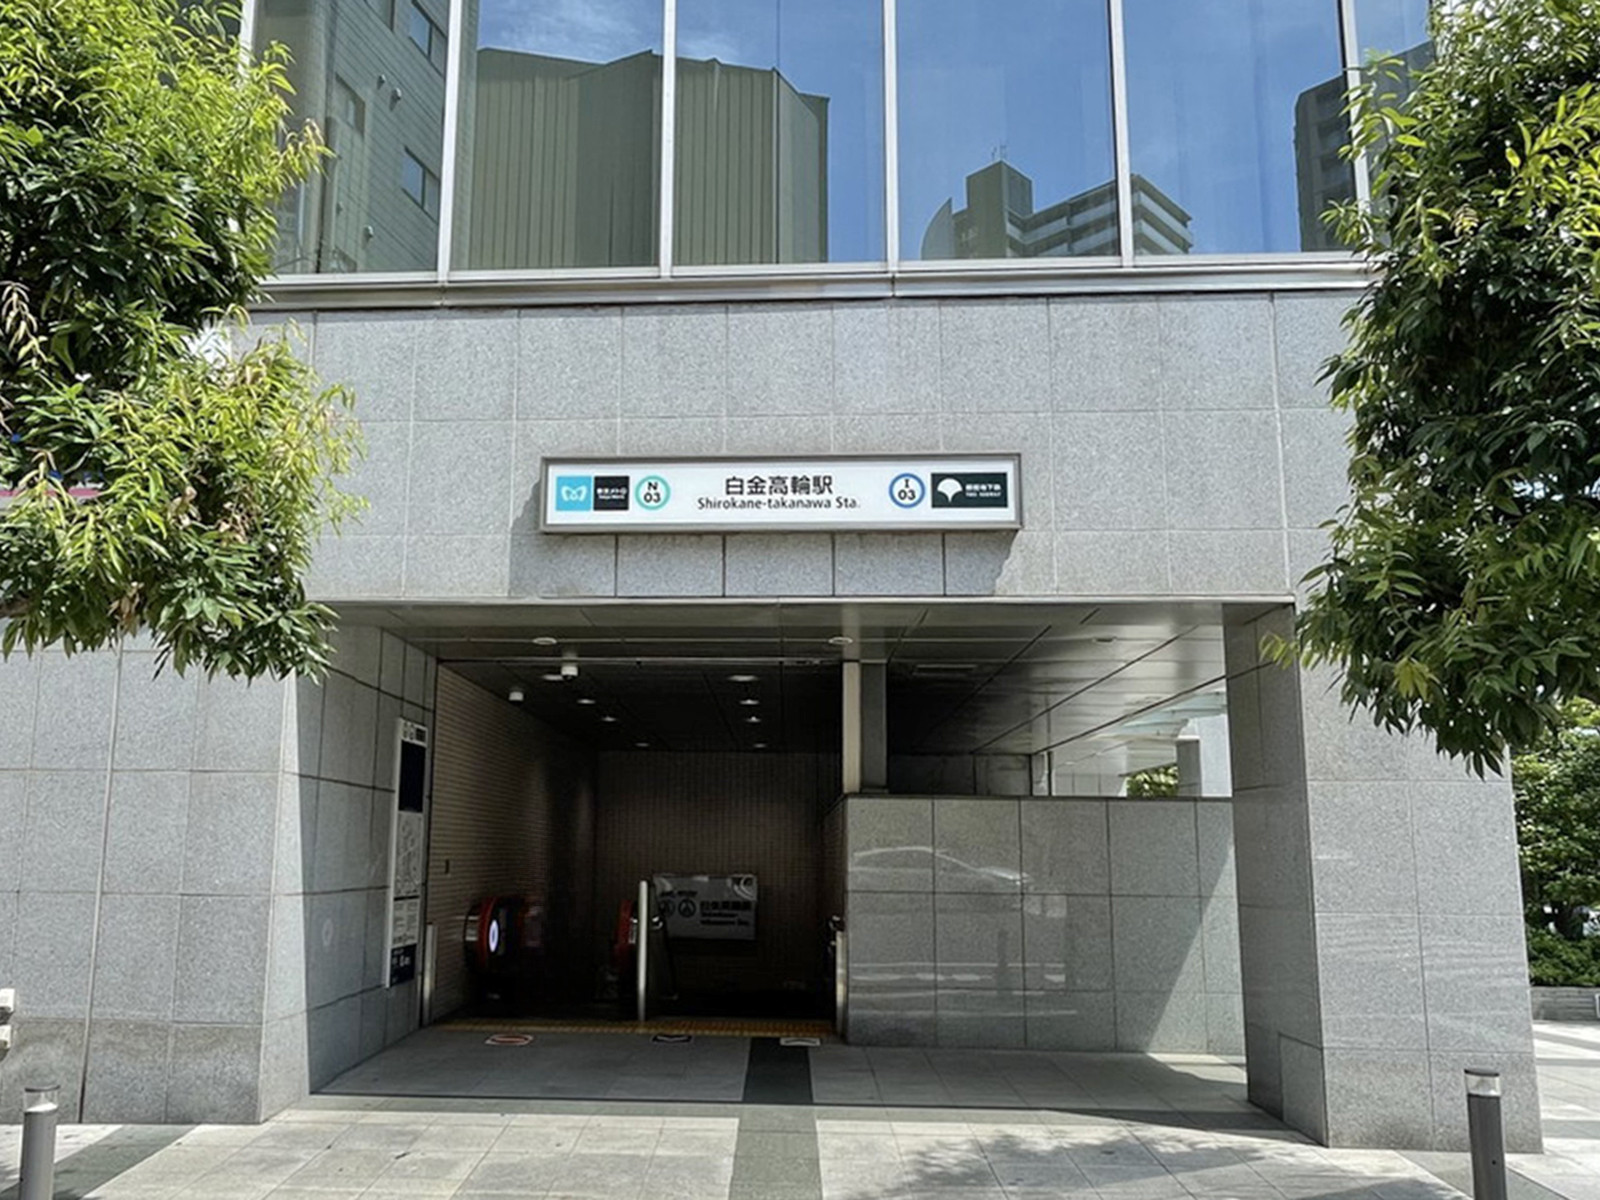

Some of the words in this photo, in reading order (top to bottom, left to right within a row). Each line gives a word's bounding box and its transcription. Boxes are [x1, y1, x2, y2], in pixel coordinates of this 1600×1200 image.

[647, 481, 658, 491] N
[725, 475, 833, 496] 白金高輪駅
[904, 479, 910, 488] I
[643, 492, 661, 503] 03
[898, 489, 916, 501] 03
[697, 497, 832, 510] Shirokane-takanawa
[835, 496, 861, 509] Sta.
